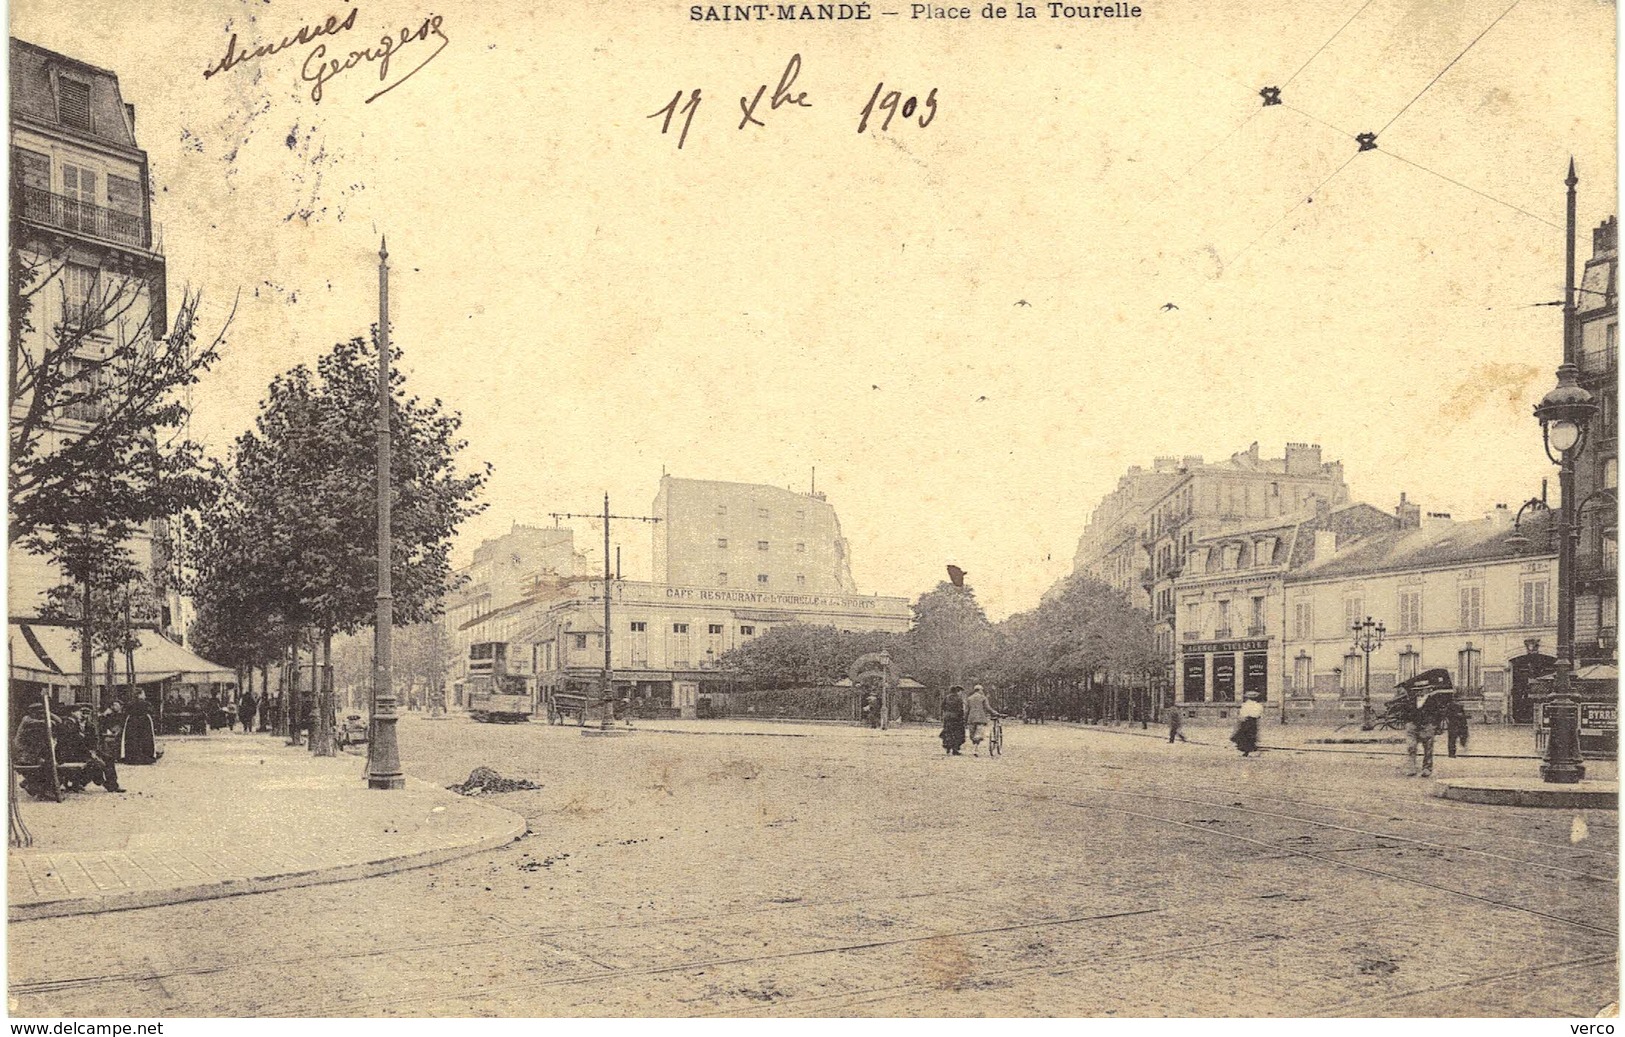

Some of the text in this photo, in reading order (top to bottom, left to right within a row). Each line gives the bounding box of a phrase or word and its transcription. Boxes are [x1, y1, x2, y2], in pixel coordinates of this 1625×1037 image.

[700, 590, 763, 603] RESTAURANT
[841, 599, 876, 609] SPORTS
[1188, 644, 1218, 652] AGENCE
